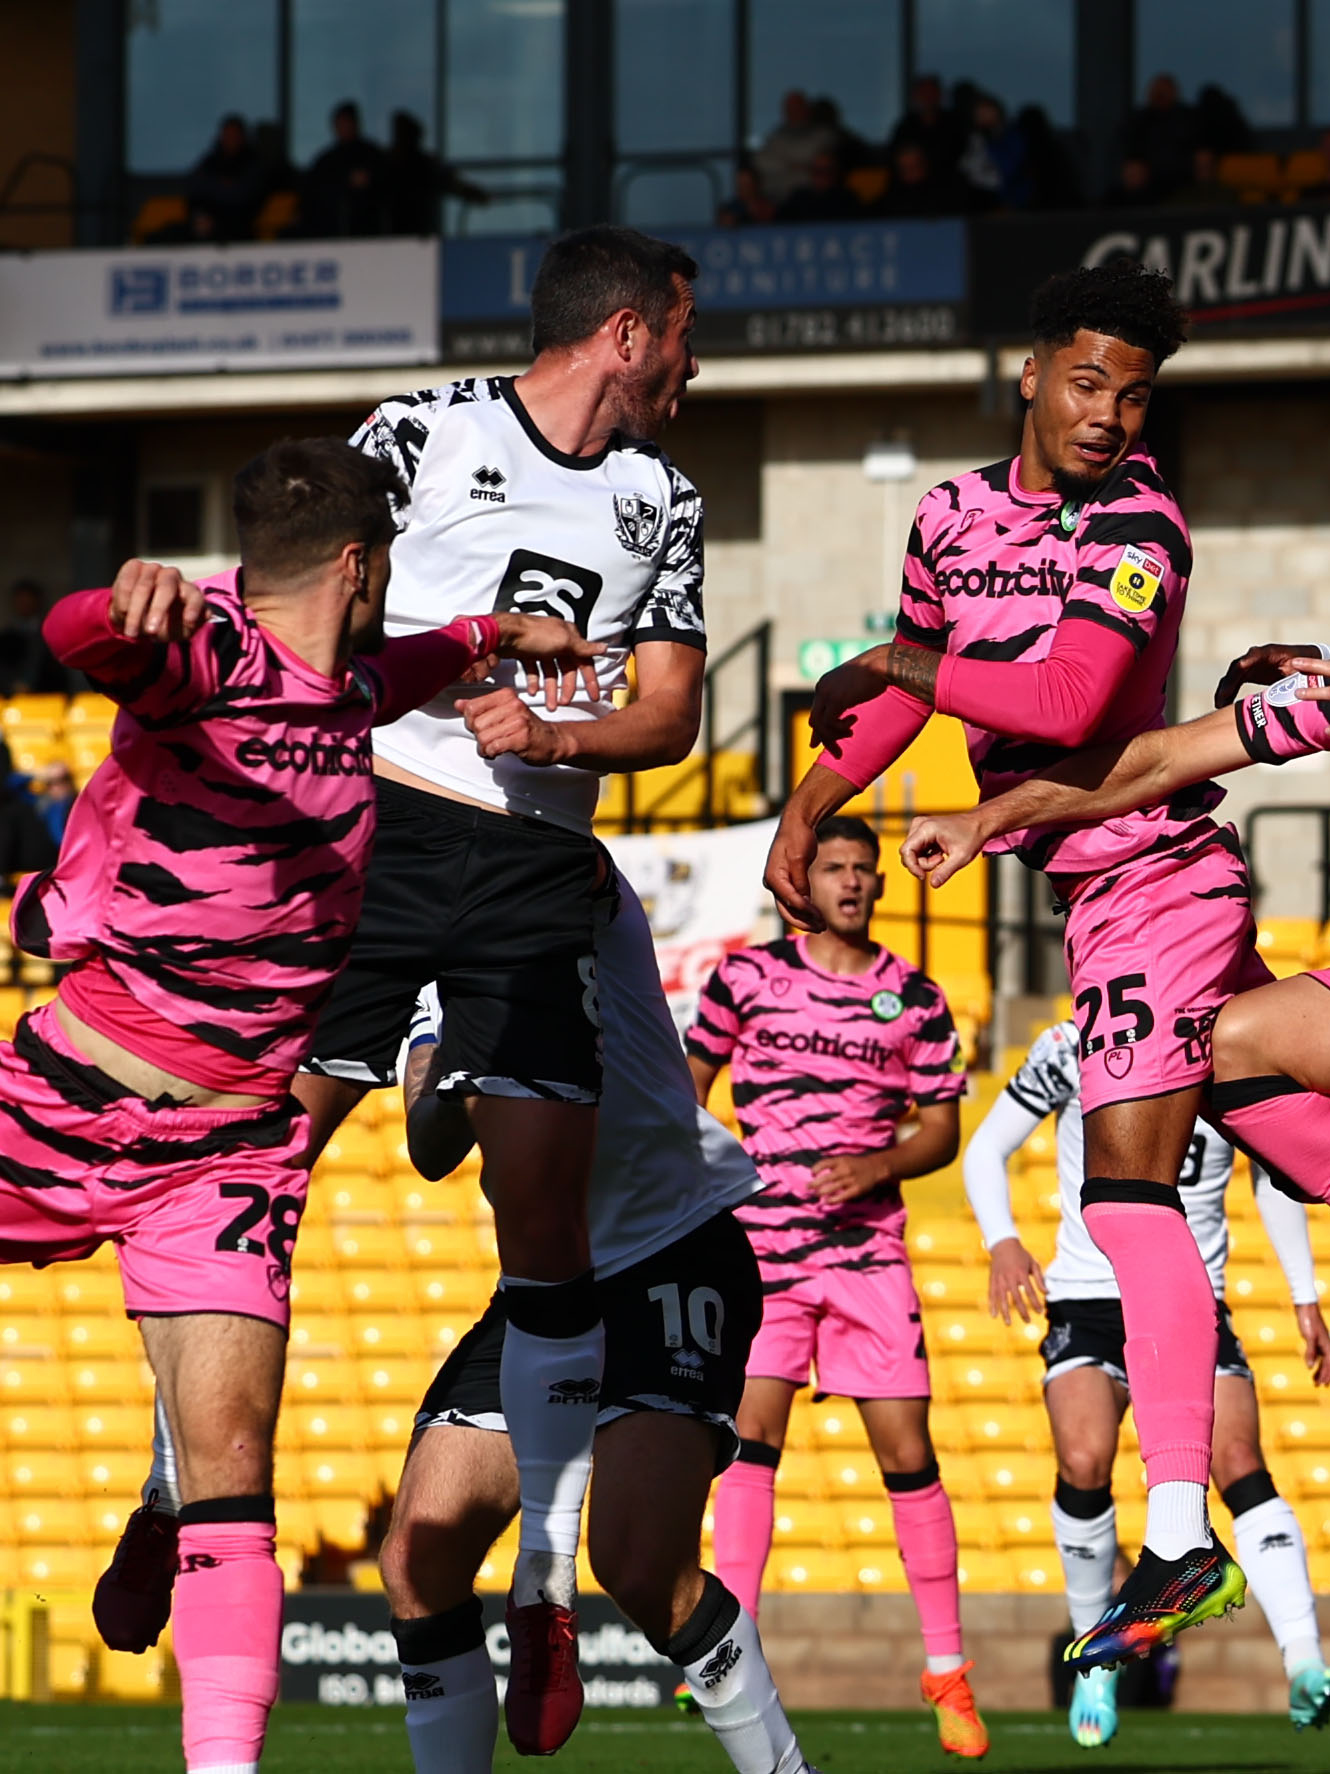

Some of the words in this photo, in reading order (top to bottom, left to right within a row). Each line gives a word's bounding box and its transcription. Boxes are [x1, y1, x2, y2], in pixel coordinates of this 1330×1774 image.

[692, 229, 900, 270] ONTRACT
[697, 264, 899, 298] URNITURE
[1127, 551, 1142, 564] sky
[934, 557, 1074, 605] ecotricity
[1075, 972, 1155, 1062] 25
[756, 1028, 895, 1071] ecotricity
[214, 1182, 302, 1278] 28
[647, 1282, 725, 1356] 10
[281, 1621, 399, 1664] Globa
